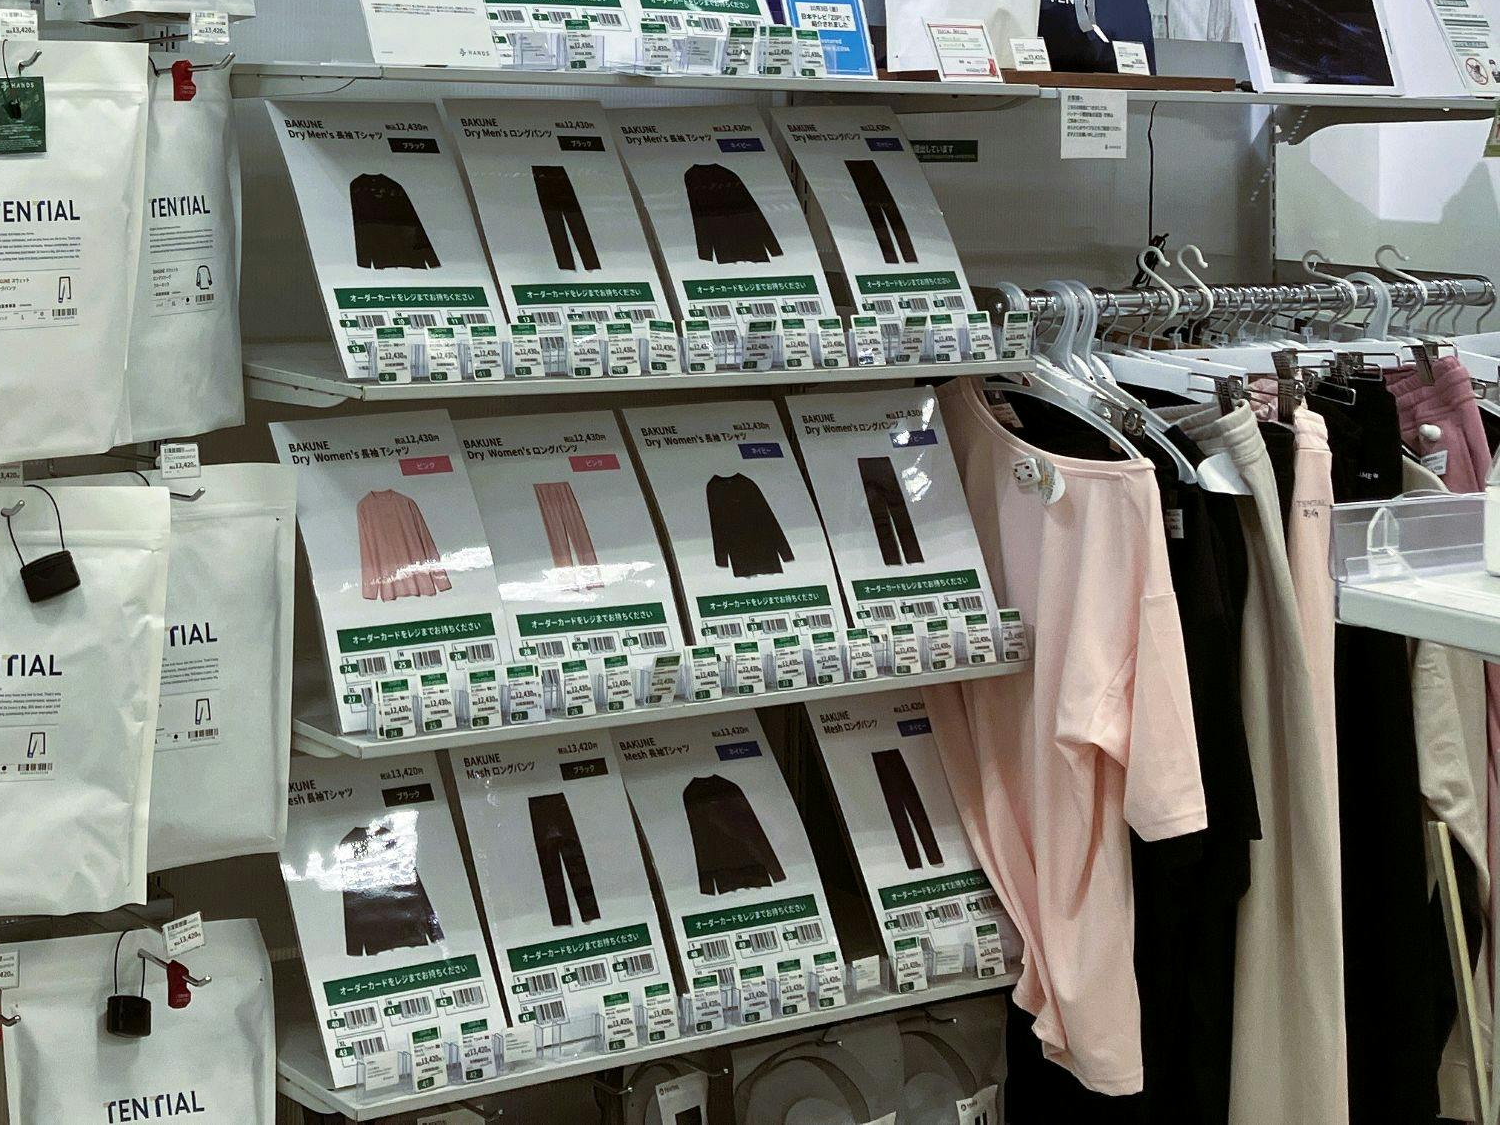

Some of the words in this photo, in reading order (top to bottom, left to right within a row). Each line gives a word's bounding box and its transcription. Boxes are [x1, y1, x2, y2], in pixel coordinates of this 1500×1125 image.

[285, 119, 324, 130] BAKUNE
[461, 118, 498, 127] BAKUNE
[787, 124, 817, 132] BAKUNE
[288, 130, 305, 141] Dry
[307, 130, 335, 140] Men's
[464, 128, 481, 139] Dry
[483, 128, 508, 138] Men's
[621, 125, 657, 135] BAKUNE
[626, 135, 642, 146] Dry
[645, 135, 668, 145] Men's
[792, 133, 806, 143] Dry
[808, 133, 827, 142] Men's
[148, 194, 211, 218] TENTIAL
[802, 413, 835, 424] BAKUNE
[641, 426, 678, 436] BAKUNE
[805, 424, 821, 435] Dry
[823, 422, 858, 433] Women's
[288, 441, 330, 453] BAKUNE
[463, 437, 503, 448] BAKUNE
[645, 436, 661, 448] Dry
[666, 433, 704, 445] Women's
[292, 453, 310, 466] Dry
[315, 449, 359, 462] Women's
[467, 448, 484, 461] Dry
[488, 445, 532, 458] Women's
[533, 444, 578, 455] ロングパンツ
[531, 611, 653, 629] オーダーカードをレジまでお持ちください
[166, 622, 218, 647] TIAL
[352, 621, 482, 645] オーダーカードをレジまでお持ちください
[820, 711, 851, 724] BAKUNE
[824, 722, 842, 735] Mesh
[619, 737, 655, 751] BAKUNE
[463, 753, 500, 767] BAKUNE
[624, 750, 648, 762] Mesh
[467, 766, 491, 779] Mesh
[492, 761, 535, 776] ロングパンツ
[288, 779, 317, 792] KUNE
[307, 788, 353, 803] 長袖Tシャツ
[522, 933, 640, 963] オーダーカードをレジまでお持ちください
[339, 963, 468, 995] オーダーカードをレジまでお持ちください
[104, 1090, 205, 1125] TENTIAL
